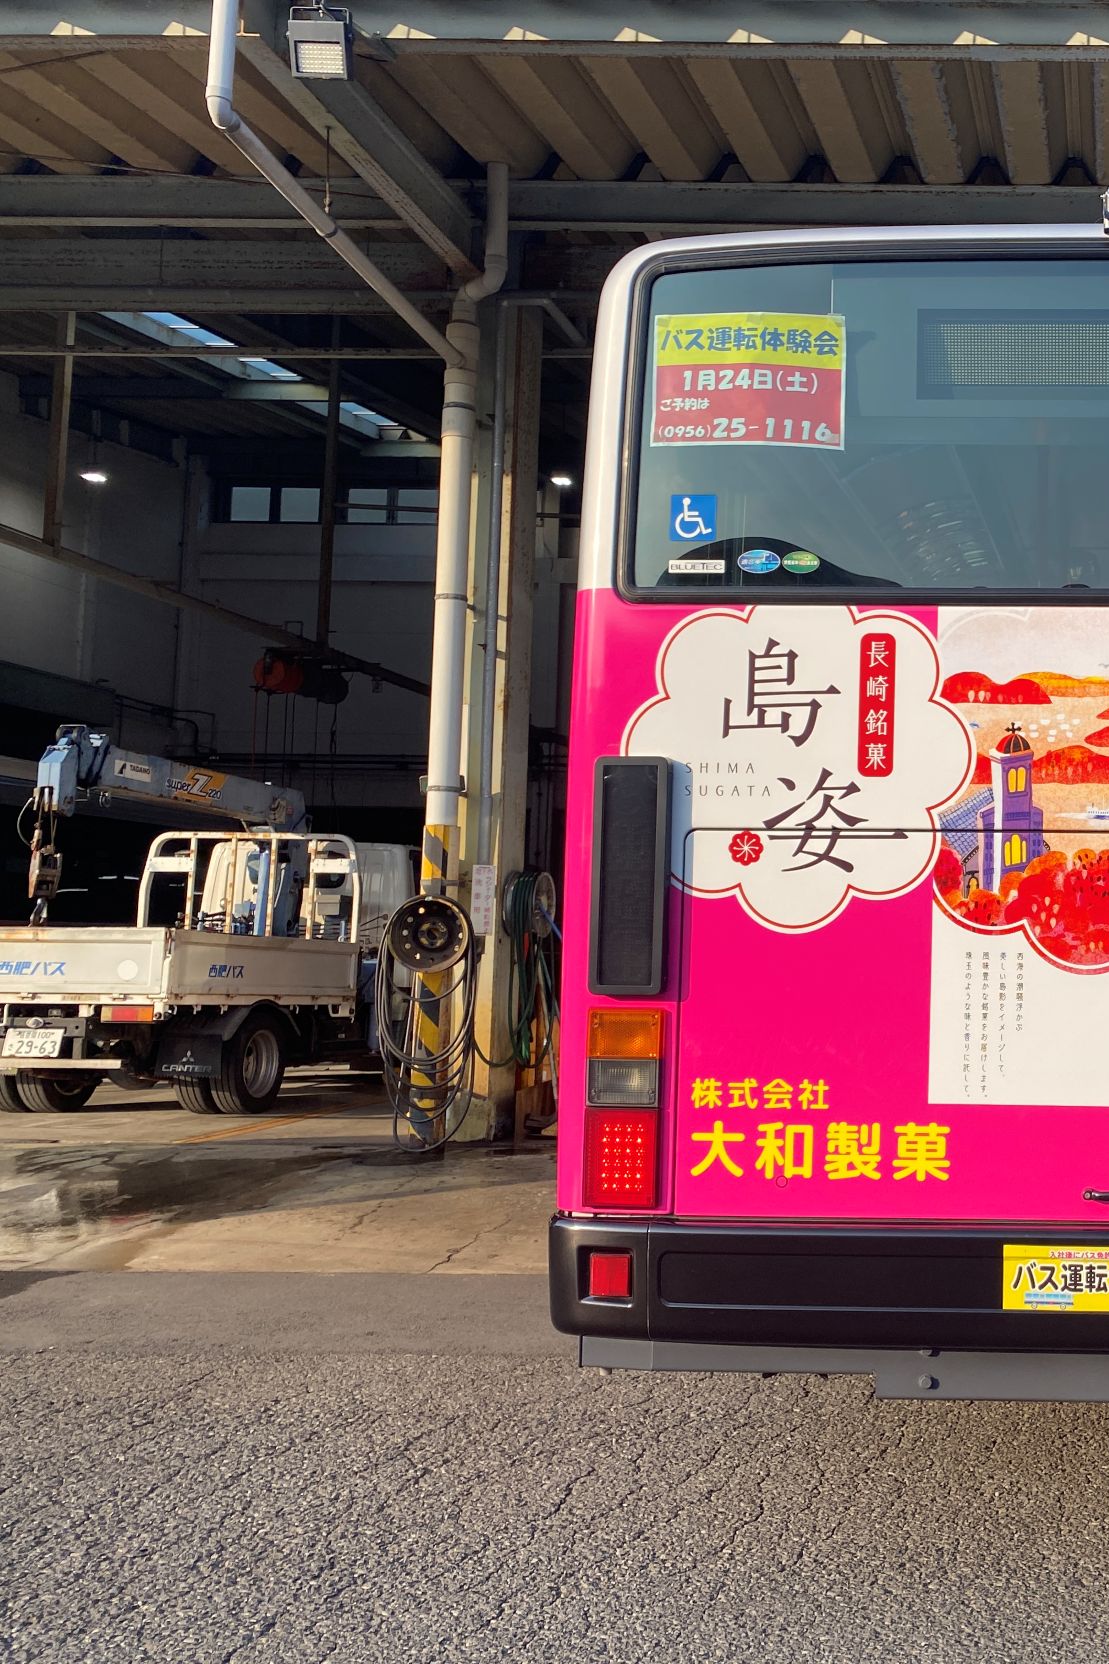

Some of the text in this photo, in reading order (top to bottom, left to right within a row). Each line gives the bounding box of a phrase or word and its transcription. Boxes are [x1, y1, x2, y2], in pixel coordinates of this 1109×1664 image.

[660, 326, 840, 357] バス運転体験会
[659, 397, 710, 412] ご予約は
[670, 562, 723, 571] BLUETEC
[864, 640, 890, 771] 長崎銘菓
[685, 762, 755, 774] SHIMA
[684, 784, 771, 797] SUGATA
[207, 964, 245, 978] 西肥バス
[15, 1040, 58, 1054] 29-63
[161, 1063, 212, 1072] CANTER
[690, 1077, 830, 1110] 株式会社
[690, 1120, 951, 1182] 大和製菓
